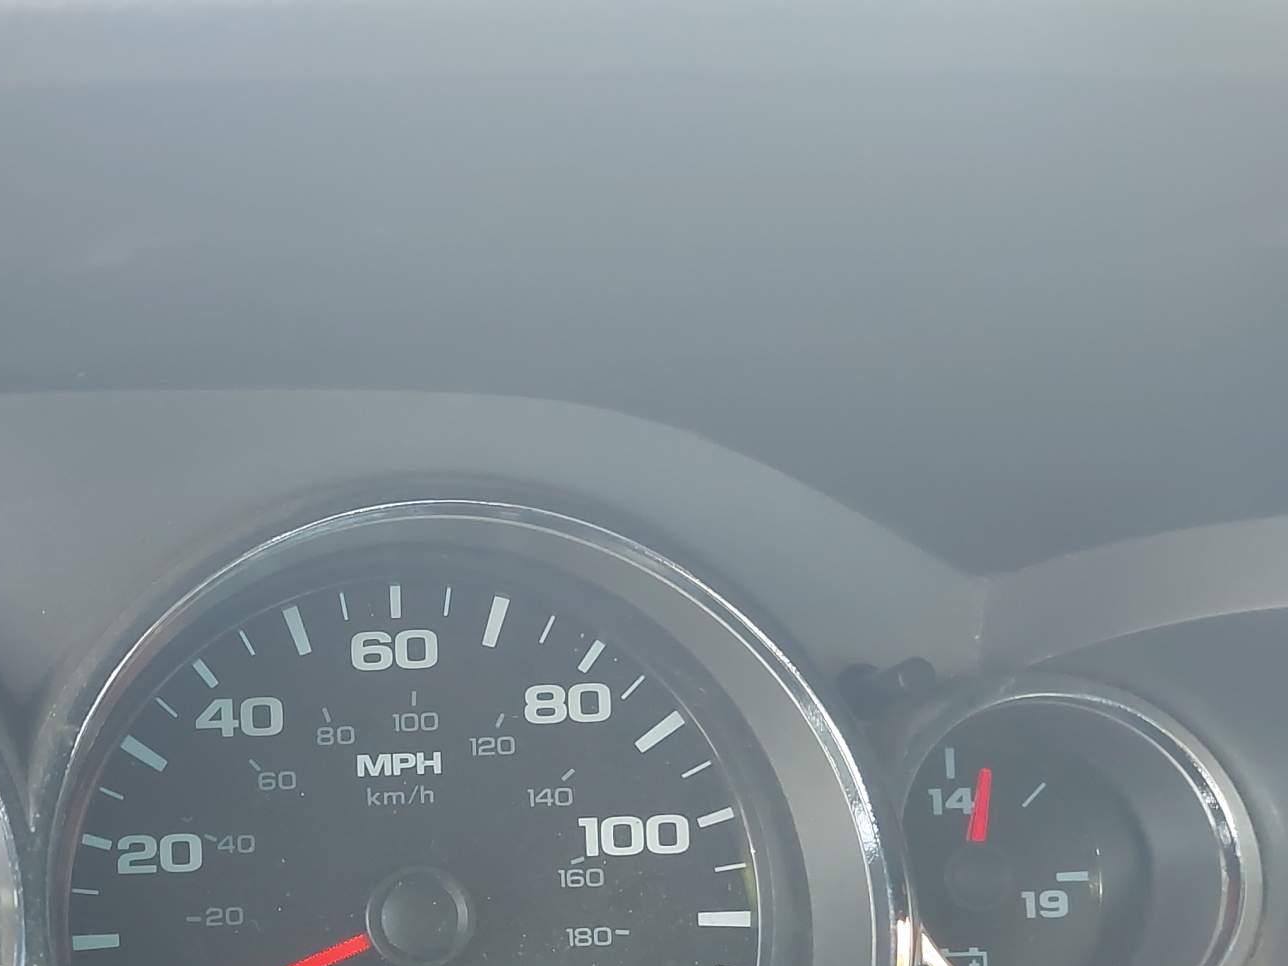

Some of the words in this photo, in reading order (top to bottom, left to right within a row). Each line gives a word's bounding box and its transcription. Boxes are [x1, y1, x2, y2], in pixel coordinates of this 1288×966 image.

[351, 630, 437, 670] 60
[525, 683, 611, 723] 80
[196, 697, 283, 737] 40
[393, 713, 439, 732] 100
[317, 726, 355, 746] 80
[470, 737, 516, 756] 120
[357, 752, 442, 776] MPH
[258, 771, 297, 791] 60
[367, 785, 435, 805] km/h
[528, 788, 573, 807] 140
[928, 788, 975, 815] 14
[218, 835, 255, 853] 40
[578, 815, 689, 856] 100
[118, 834, 202, 873] 20
[558, 869, 604, 888] 160
[1022, 890, 1068, 918] 19
[566, 928, 612, 946] 180
